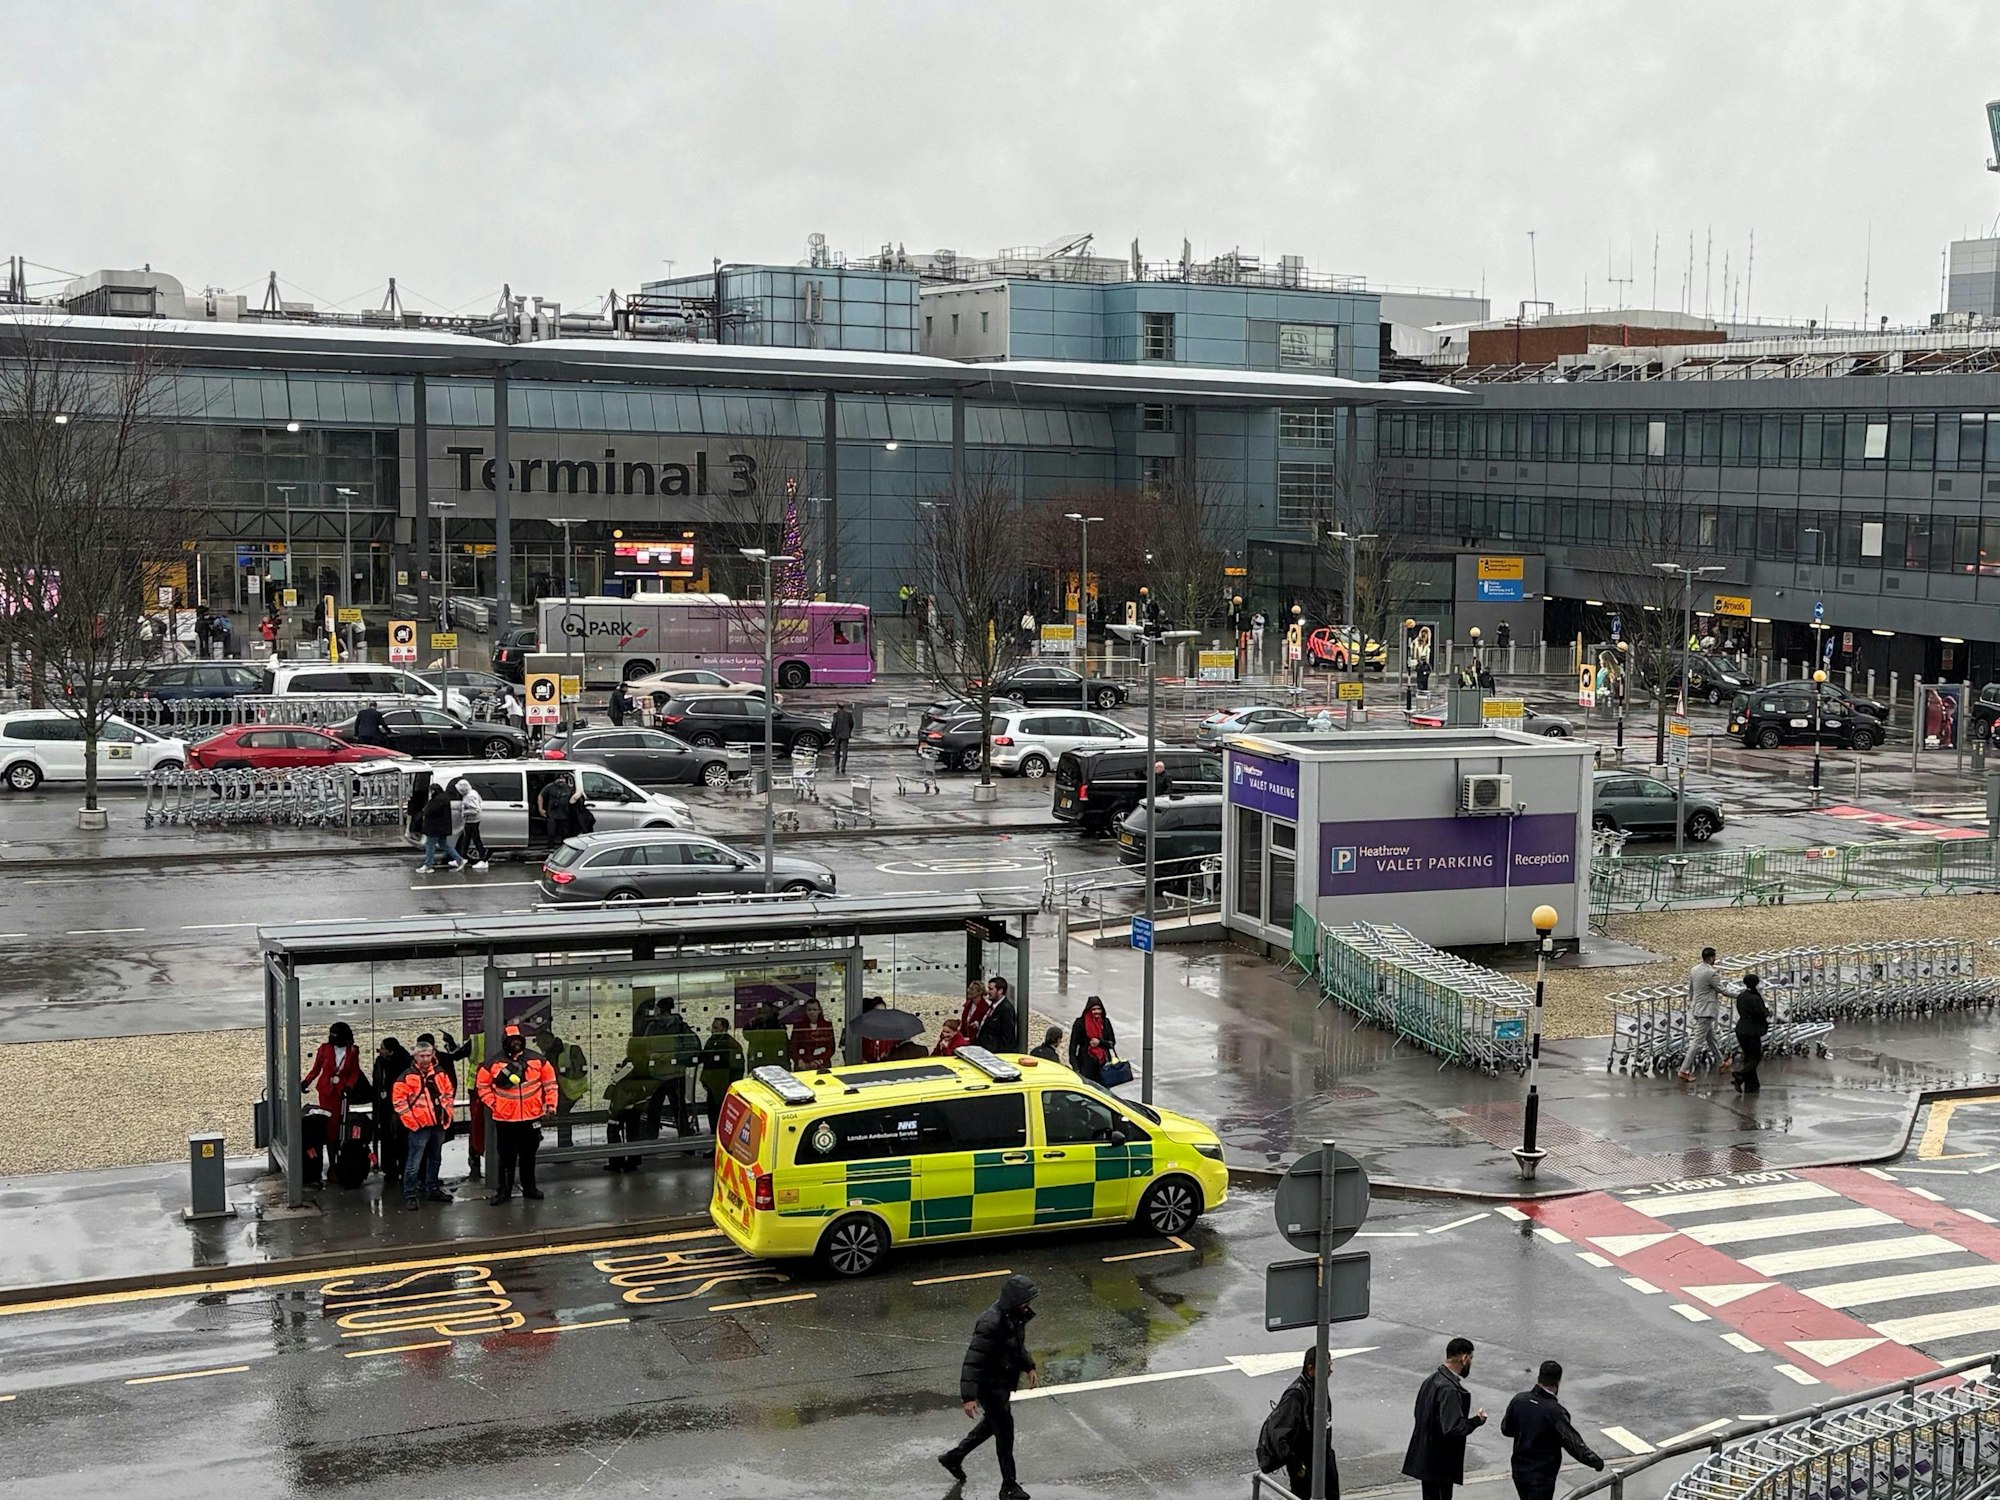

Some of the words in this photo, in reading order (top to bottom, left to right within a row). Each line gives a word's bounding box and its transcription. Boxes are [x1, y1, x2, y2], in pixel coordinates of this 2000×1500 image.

[447, 446, 707, 495] Terminal
[728, 454, 757, 497] 3
[589, 620, 632, 636] PARK
[1249, 777, 1267, 791] VALET
[1268, 782, 1295, 799] PARKING
[1359, 845, 1410, 857] Heathrow
[1515, 852, 1569, 867] Reception
[1377, 857, 1422, 872] VALET
[1428, 854, 1493, 869] PARKING
[898, 1120, 918, 1130] NHS
[1651, 1177, 1728, 1194] RIGHT
[1727, 1170, 1799, 1185] LOOK
[593, 1245, 791, 1304] BUS
[320, 1265, 526, 1338] STOP
